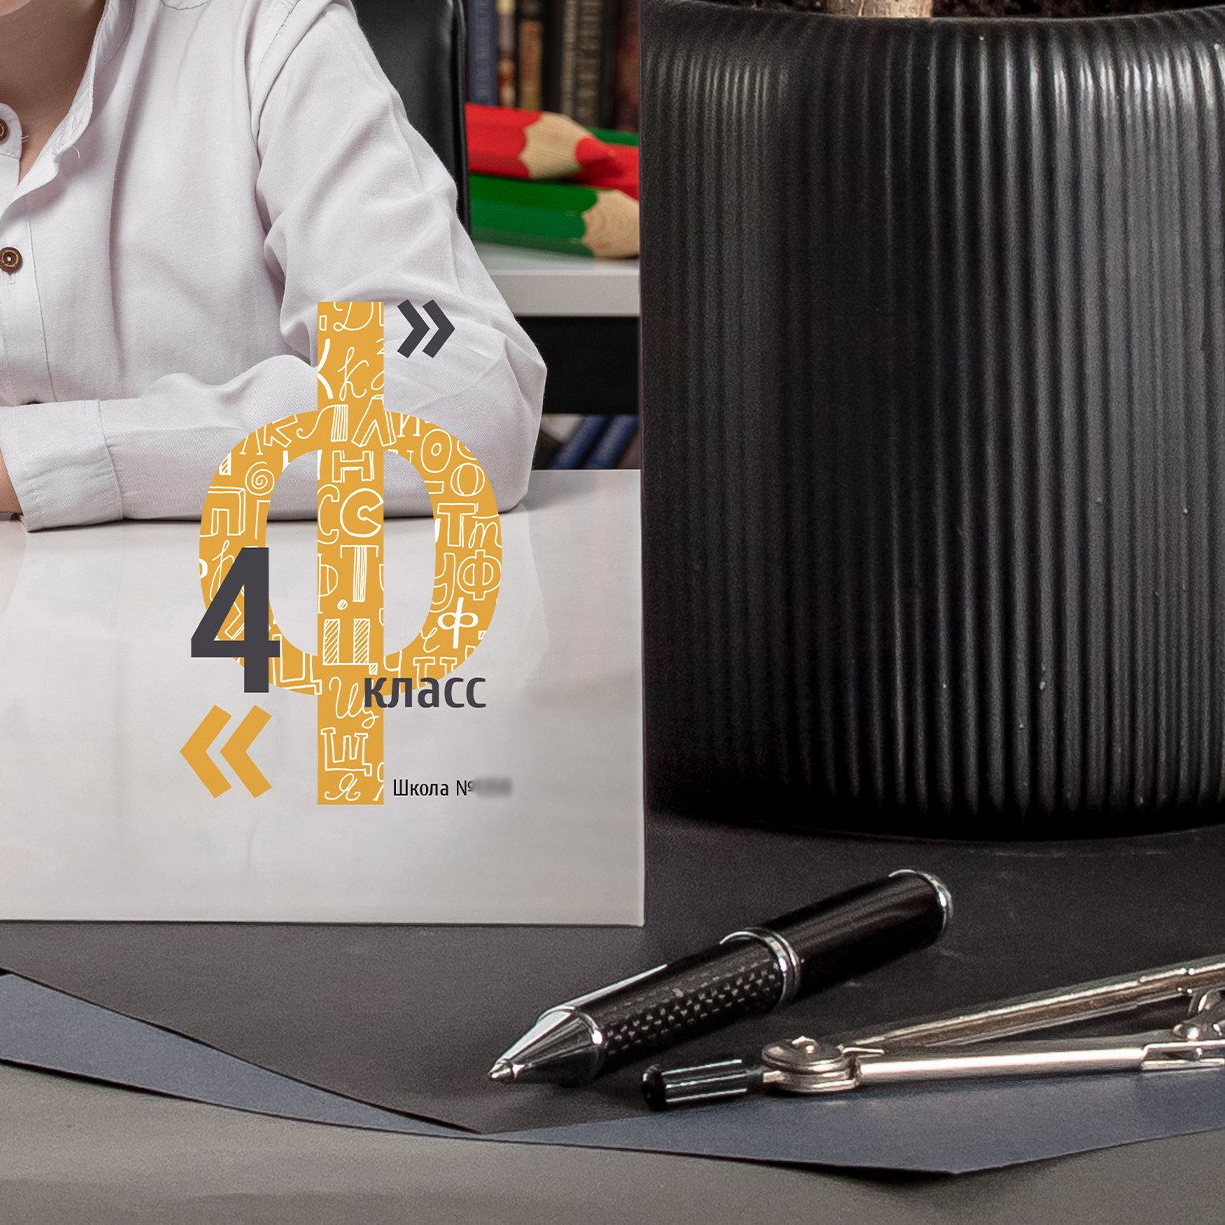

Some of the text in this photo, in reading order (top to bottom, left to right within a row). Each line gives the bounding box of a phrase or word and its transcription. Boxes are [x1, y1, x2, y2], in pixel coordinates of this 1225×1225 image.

[191, 547, 280, 693] 4
[364, 677, 487, 709] класс
[393, 778, 449, 797] Школа
